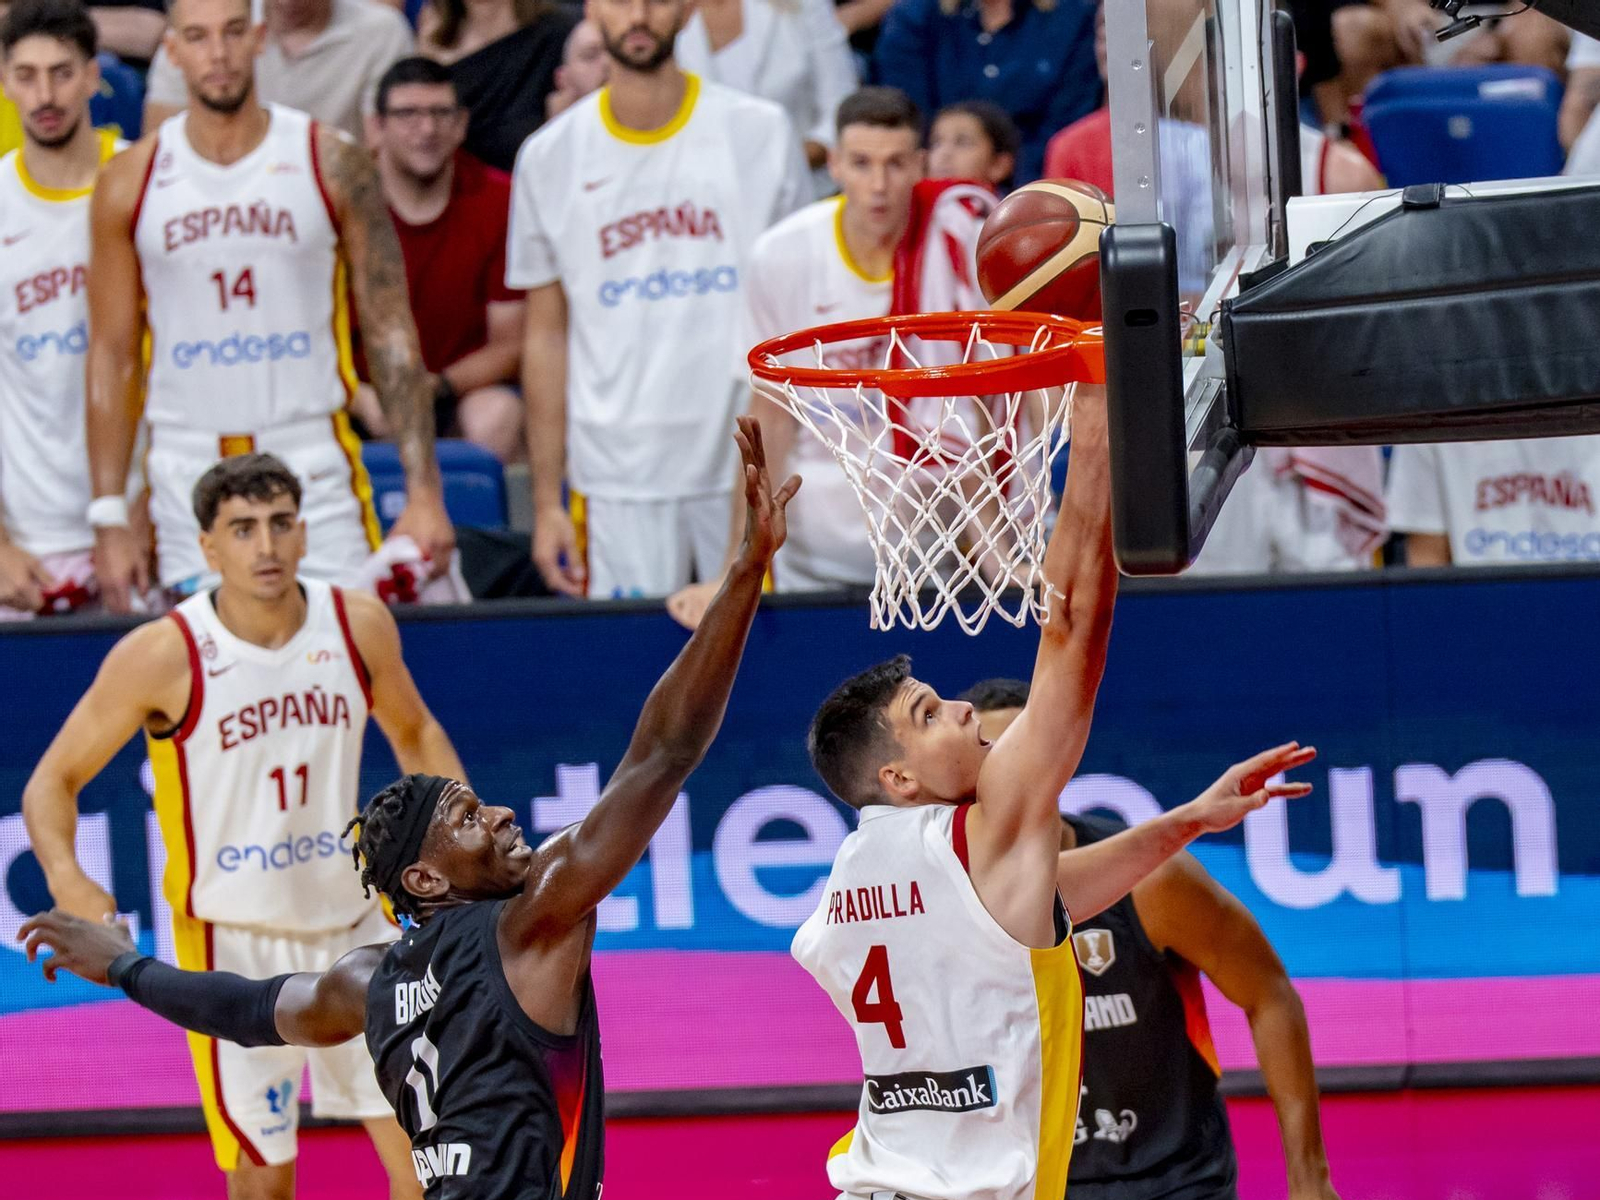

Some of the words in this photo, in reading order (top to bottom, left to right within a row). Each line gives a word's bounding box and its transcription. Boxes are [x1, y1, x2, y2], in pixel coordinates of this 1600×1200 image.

[163, 198, 298, 252] ESPAÑA
[599, 199, 723, 261] ESPAÑA
[210, 265, 256, 312] 14
[599, 265, 737, 308] endesa
[172, 331, 311, 370] endesa
[1476, 469, 1595, 517] ESPAÑA
[218, 685, 351, 751] ESPAÑA
[269, 763, 309, 811] 11
[1243, 757, 1560, 908] un
[827, 881, 925, 925] PRADILLA
[852, 945, 906, 1049] 4
[866, 1073, 991, 1110] CaixaBank
